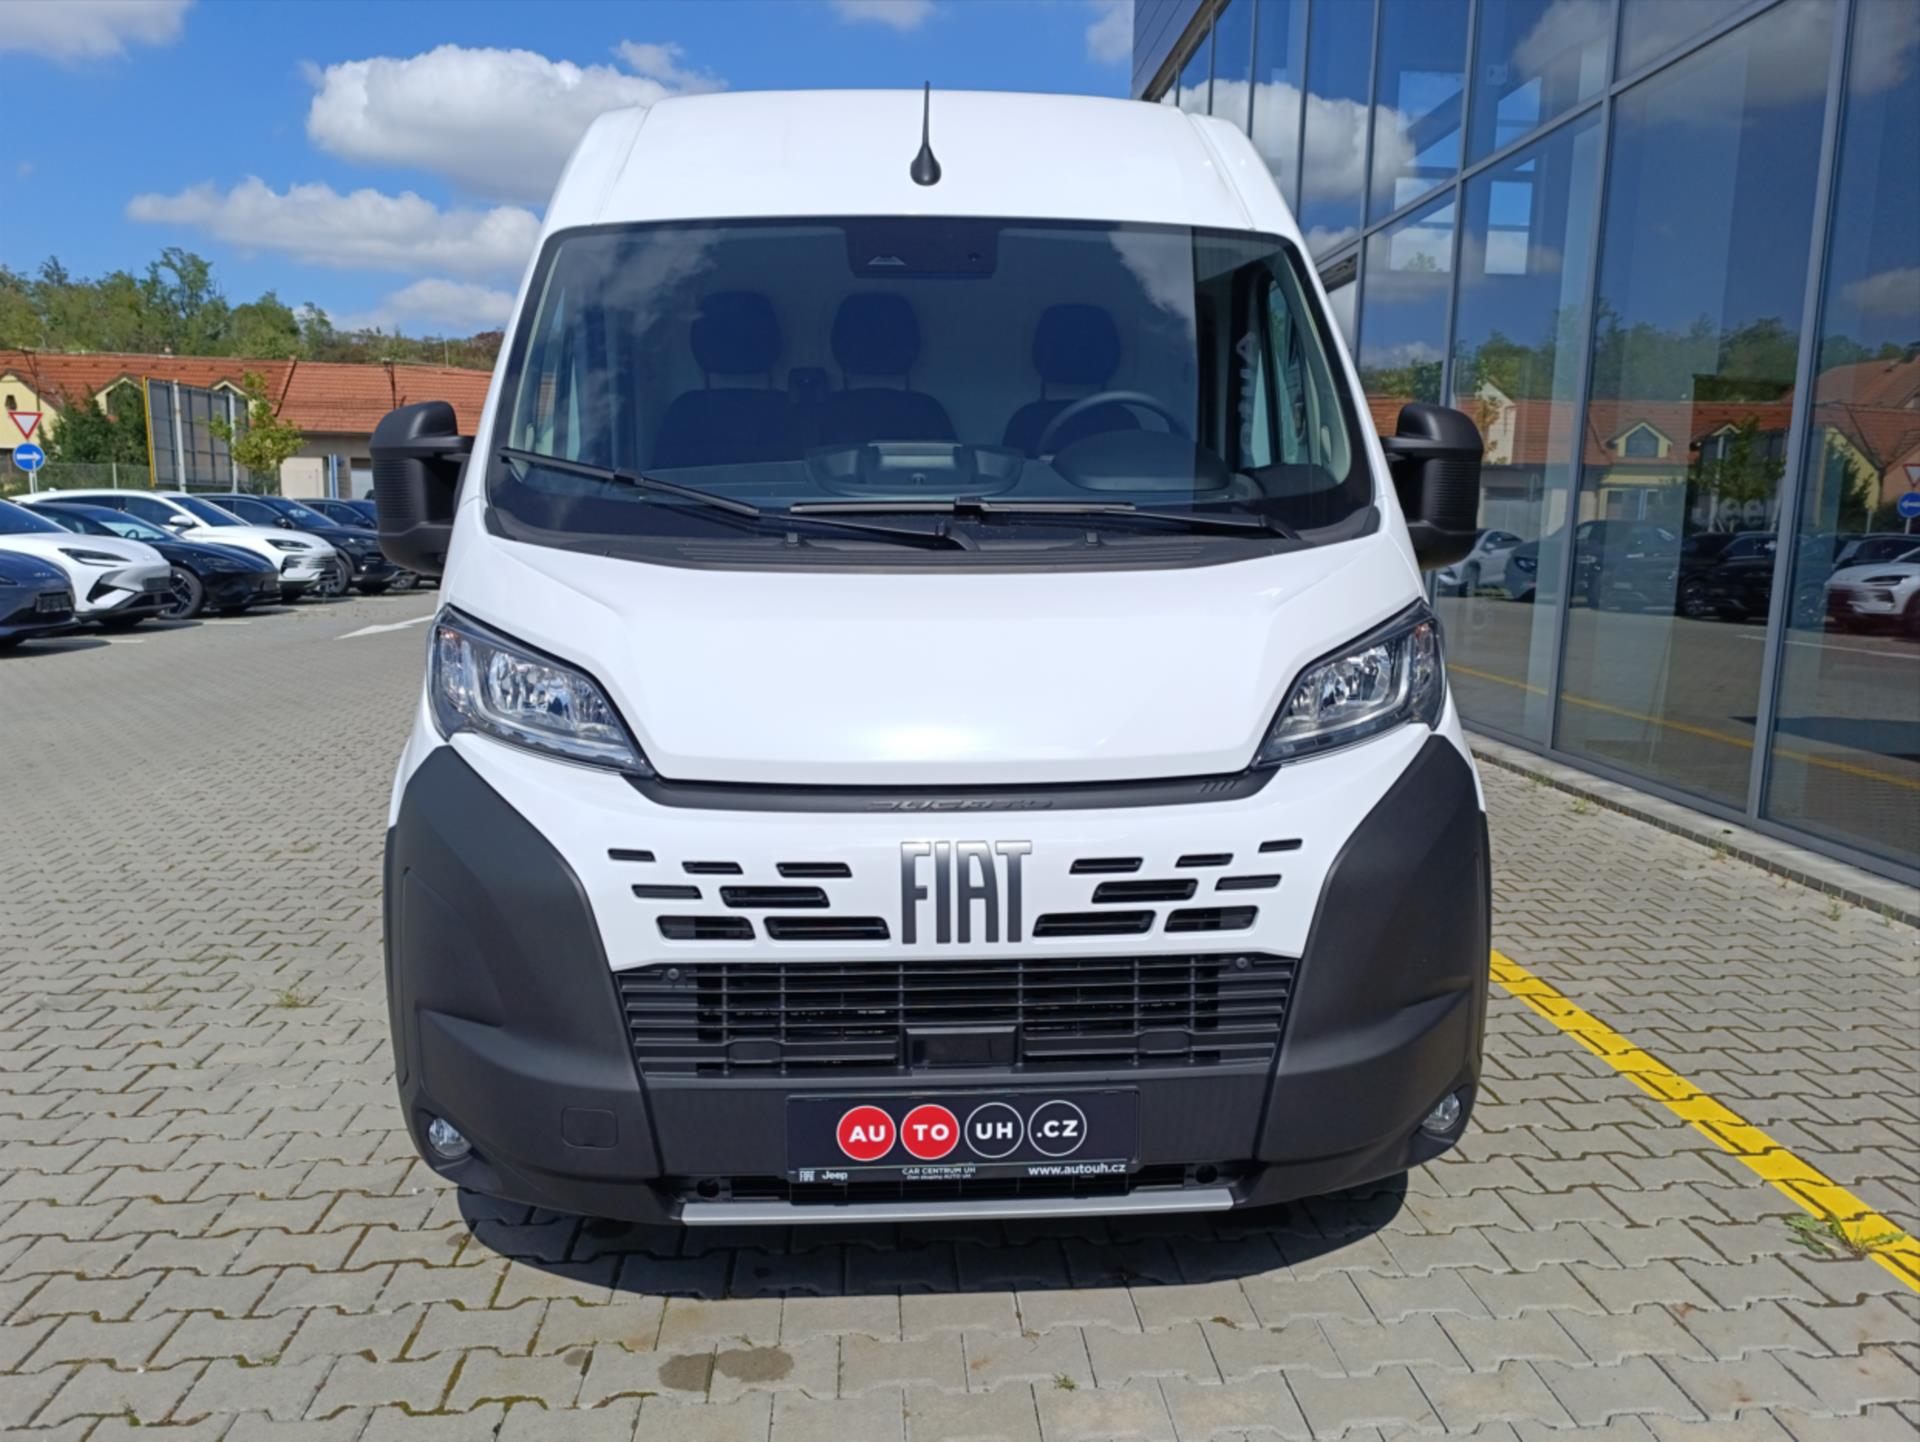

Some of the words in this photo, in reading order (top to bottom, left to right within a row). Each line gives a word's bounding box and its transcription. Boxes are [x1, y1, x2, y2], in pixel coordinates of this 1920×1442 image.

[900, 840, 1033, 944] FIAT
[848, 1125, 886, 1143] AU
[912, 1123, 950, 1141] TO
[975, 1121, 1013, 1140] UH
[1036, 1119, 1079, 1138] .CZ
[821, 1170, 848, 1182] Jeep
[922, 1167, 962, 1175] CENTRUM
[1028, 1163, 1126, 1176] www.autouh.cz
